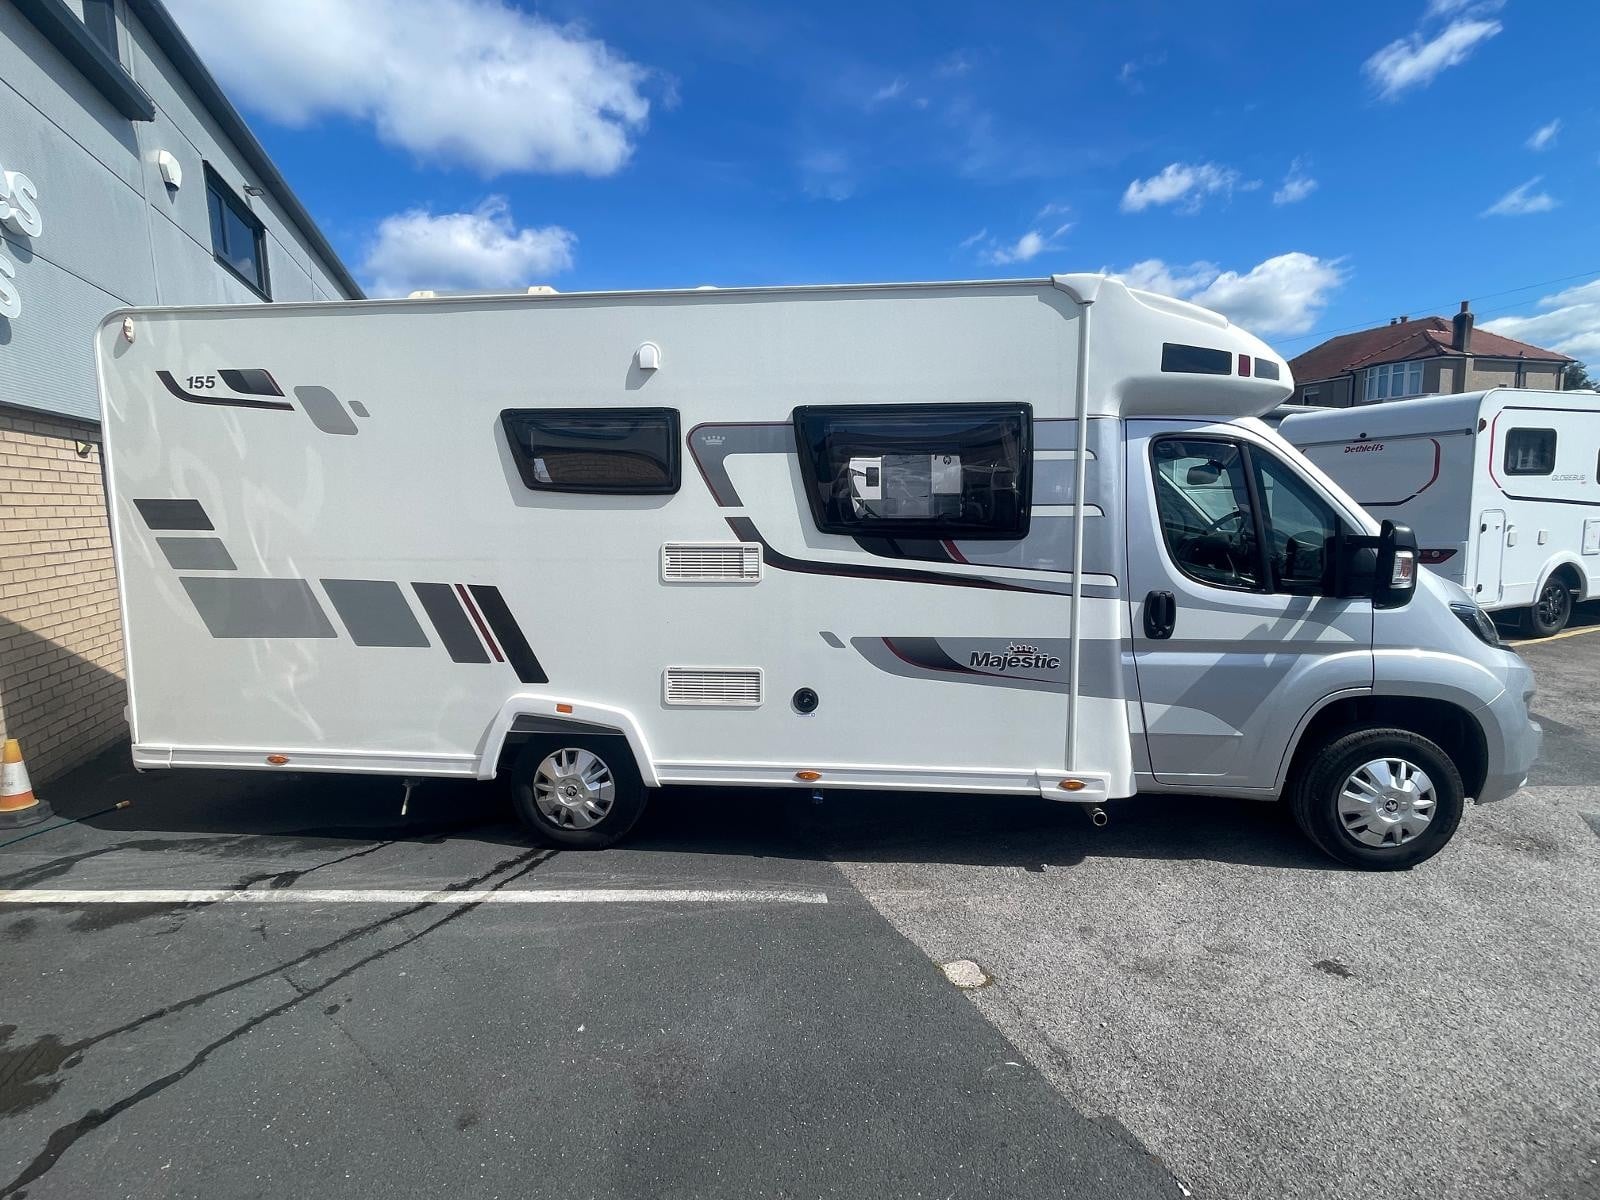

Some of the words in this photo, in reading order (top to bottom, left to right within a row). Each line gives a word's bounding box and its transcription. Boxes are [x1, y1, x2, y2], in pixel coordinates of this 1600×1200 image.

[186, 376, 216, 389] 155
[1344, 444, 1385, 453] Dethleffs
[969, 651, 1061, 672] Majestic
